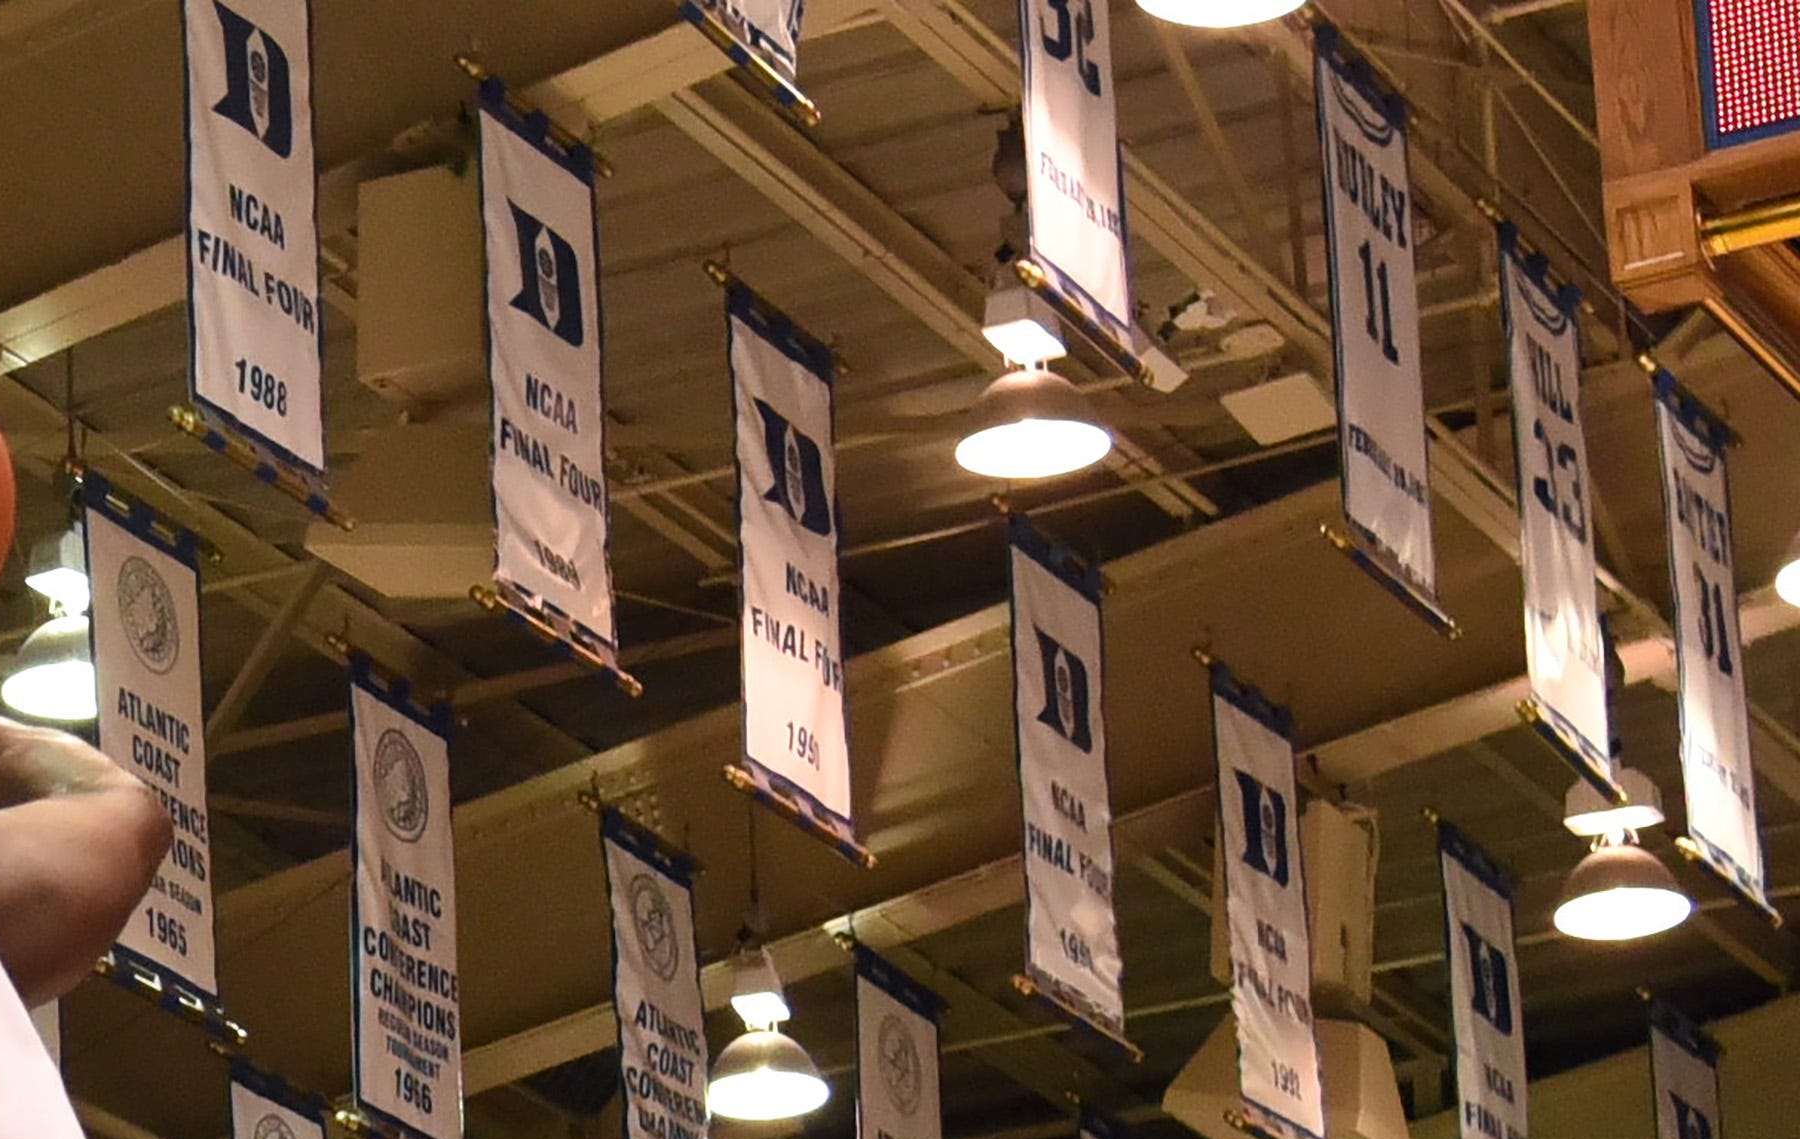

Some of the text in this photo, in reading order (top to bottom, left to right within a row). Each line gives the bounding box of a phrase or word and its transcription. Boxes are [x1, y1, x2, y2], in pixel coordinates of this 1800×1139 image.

[229, 184, 285, 250] NCAA
[198, 229, 315, 334] FINAL FOUR
[1358, 238, 1399, 366] 11
[235, 357, 287, 416] 1988
[525, 373, 578, 434] NCAA
[500, 417, 602, 514] FINAL FOUR
[786, 561, 830, 619] NCAA
[751, 606, 809, 664] FINAL
[118, 687, 190, 756] ATLANTIC
[132, 733, 181, 790] COAST
[1051, 780, 1088, 834] NCAA
[1028, 821, 1075, 875] FINAL
[145, 907, 188, 957] 1965
[647, 1041, 694, 1088] COAST
